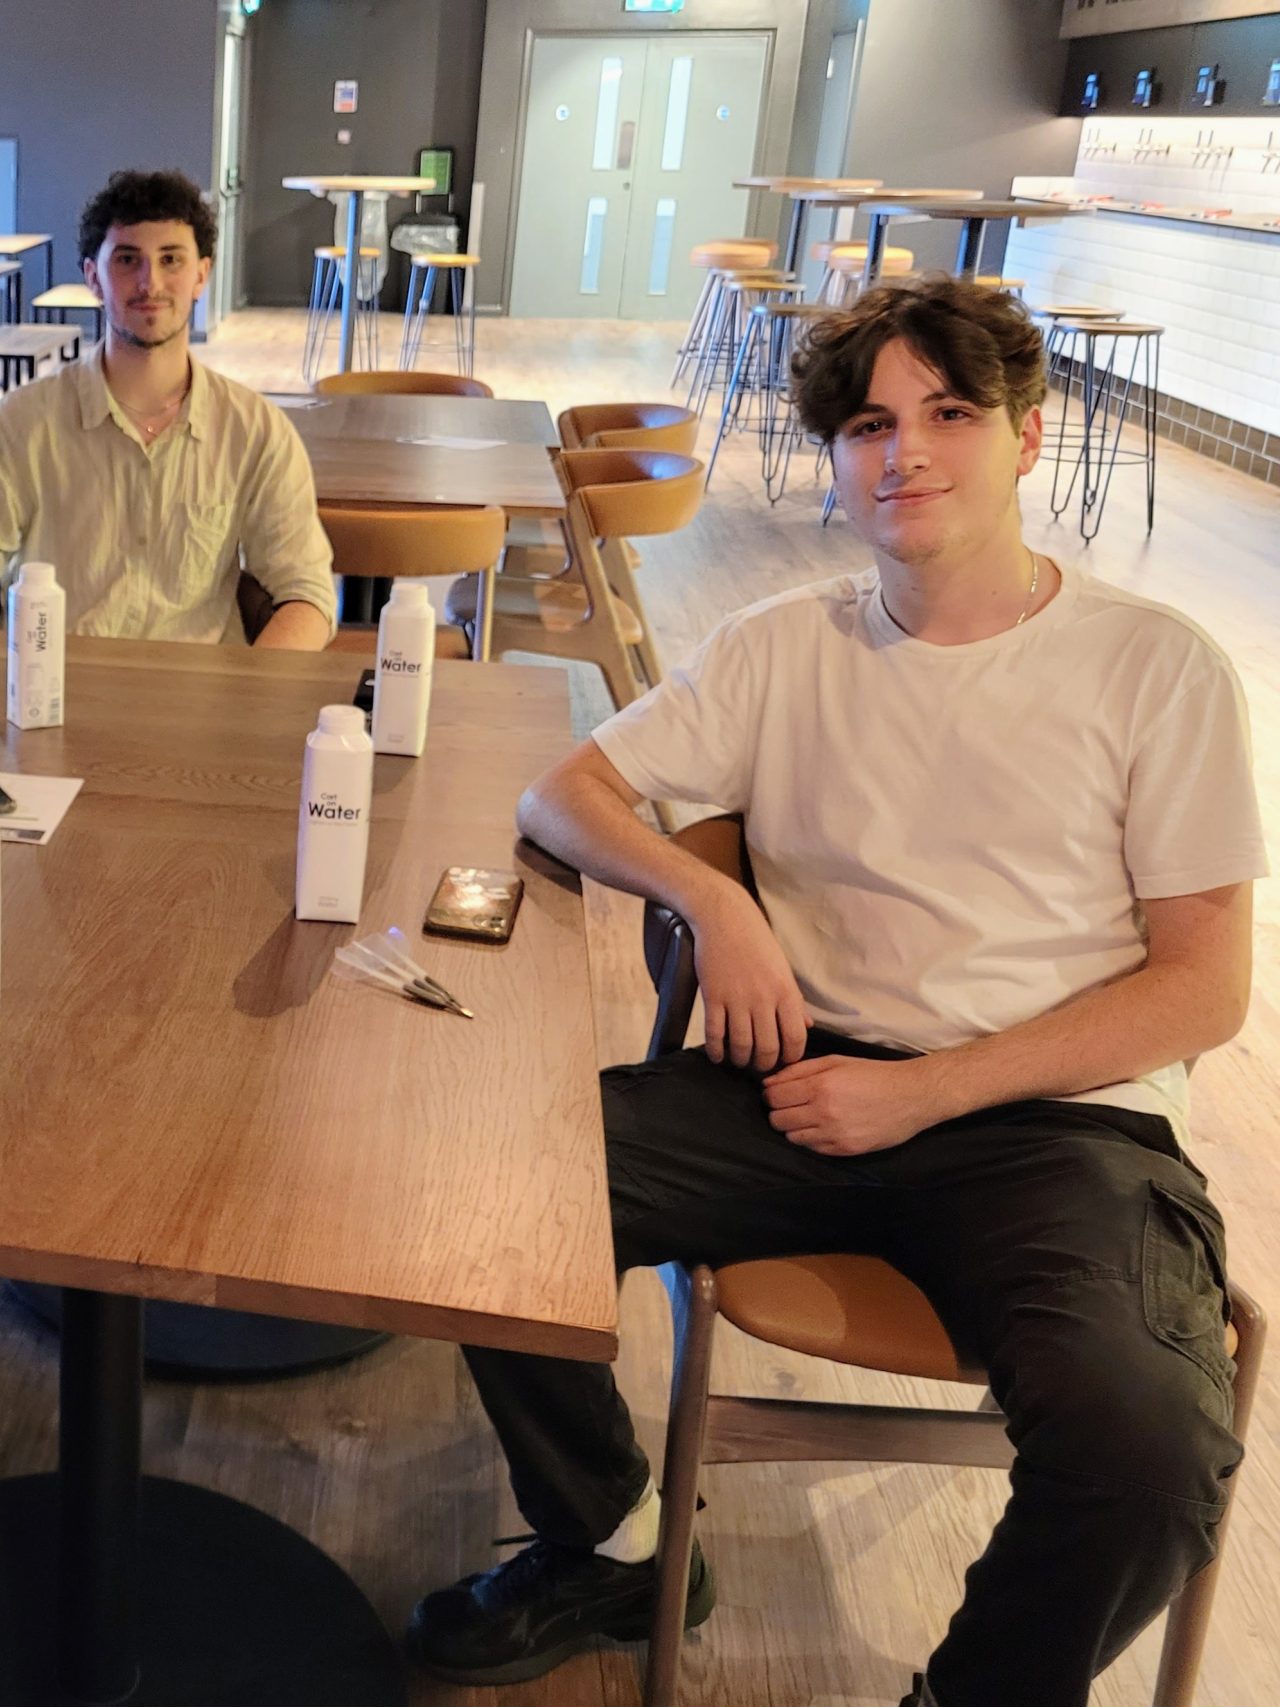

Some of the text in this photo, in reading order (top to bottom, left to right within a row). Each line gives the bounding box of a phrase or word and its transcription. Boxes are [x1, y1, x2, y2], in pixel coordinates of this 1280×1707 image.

[35, 612, 47, 652] Water
[380, 657, 422, 673] Water
[308, 800, 361, 820] Water
